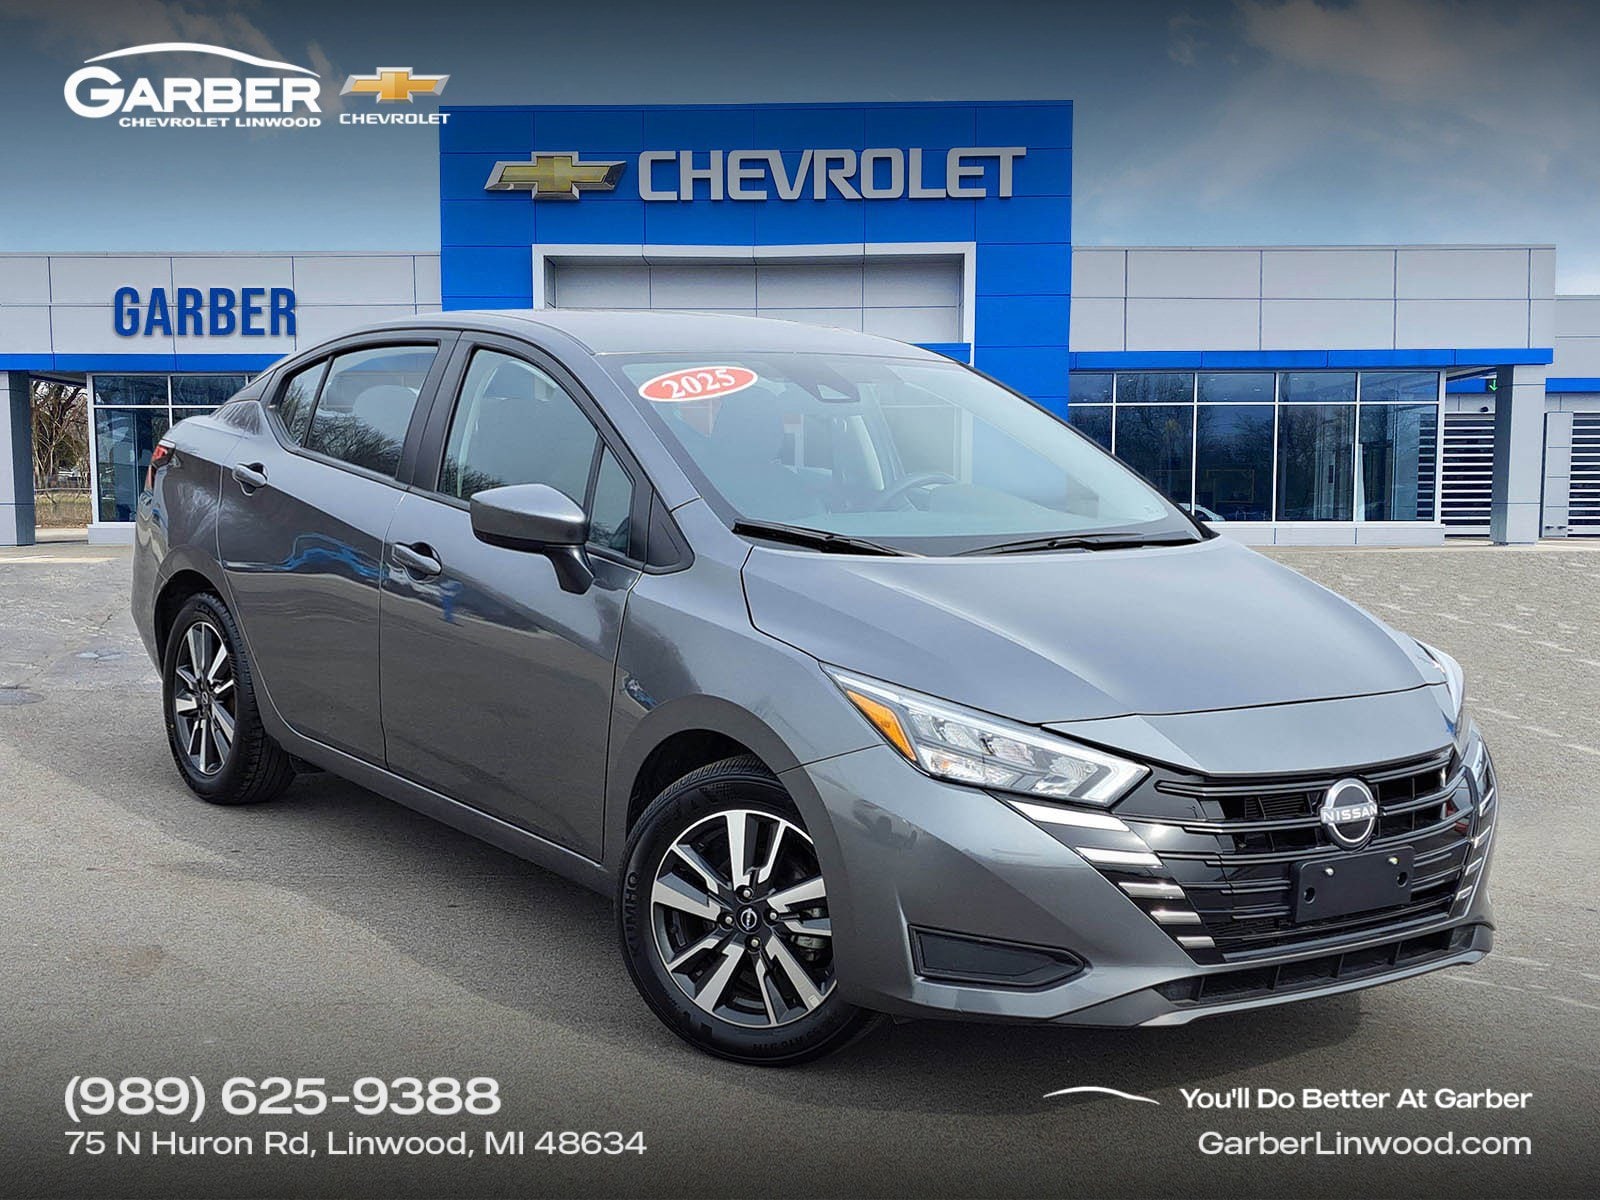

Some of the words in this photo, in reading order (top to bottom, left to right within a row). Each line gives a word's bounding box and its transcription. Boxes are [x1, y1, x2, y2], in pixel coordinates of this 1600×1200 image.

[638, 147, 1027, 202] CHEVROLET
[114, 287, 296, 336] GARBER
[661, 367, 736, 399] 2025
[1322, 803, 1378, 822] NISSAN
